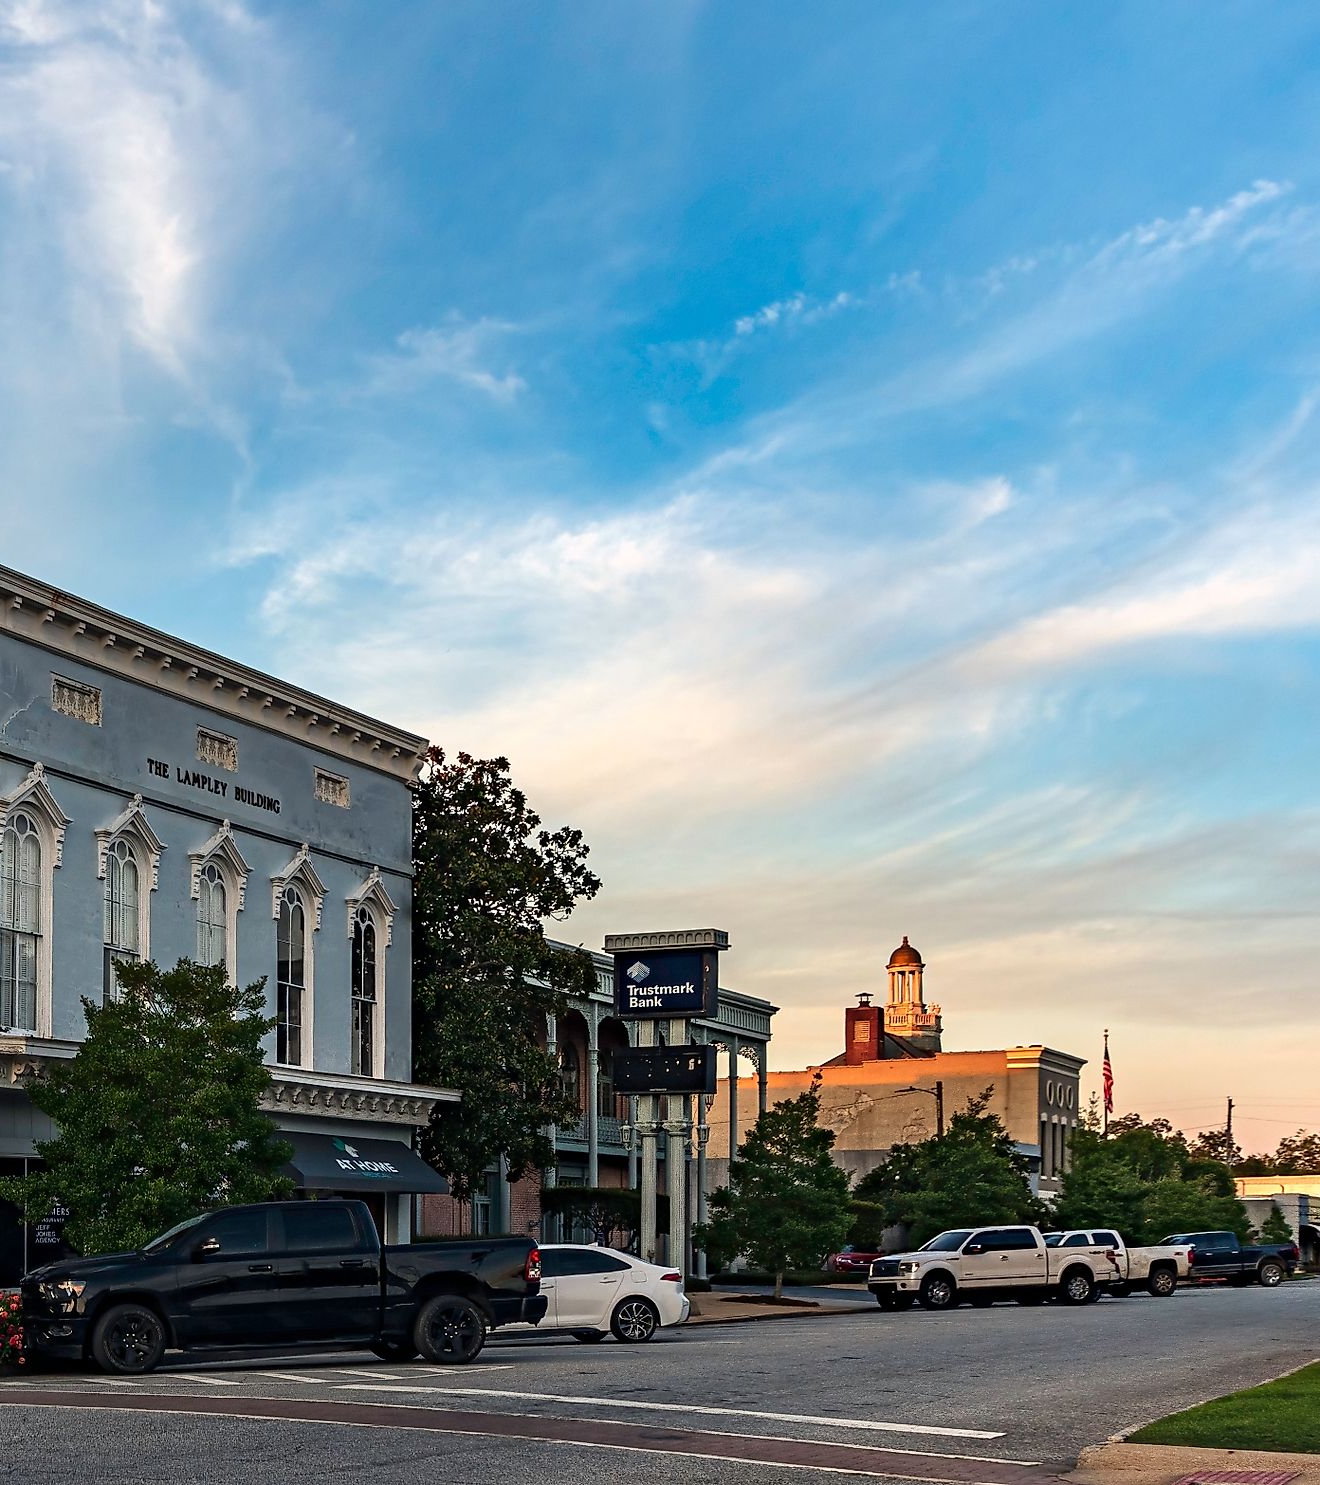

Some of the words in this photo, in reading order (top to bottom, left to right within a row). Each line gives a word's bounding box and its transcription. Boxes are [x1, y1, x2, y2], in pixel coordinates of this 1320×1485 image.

[146, 758, 169, 779] THE
[176, 767, 228, 797] LAMPLEY
[234, 785, 282, 815] BUILDING
[626, 982, 695, 996] Trustmark
[629, 996, 663, 1008] Bank
[335, 1158, 357, 1171] AT
[352, 1160, 399, 1173] HOME
